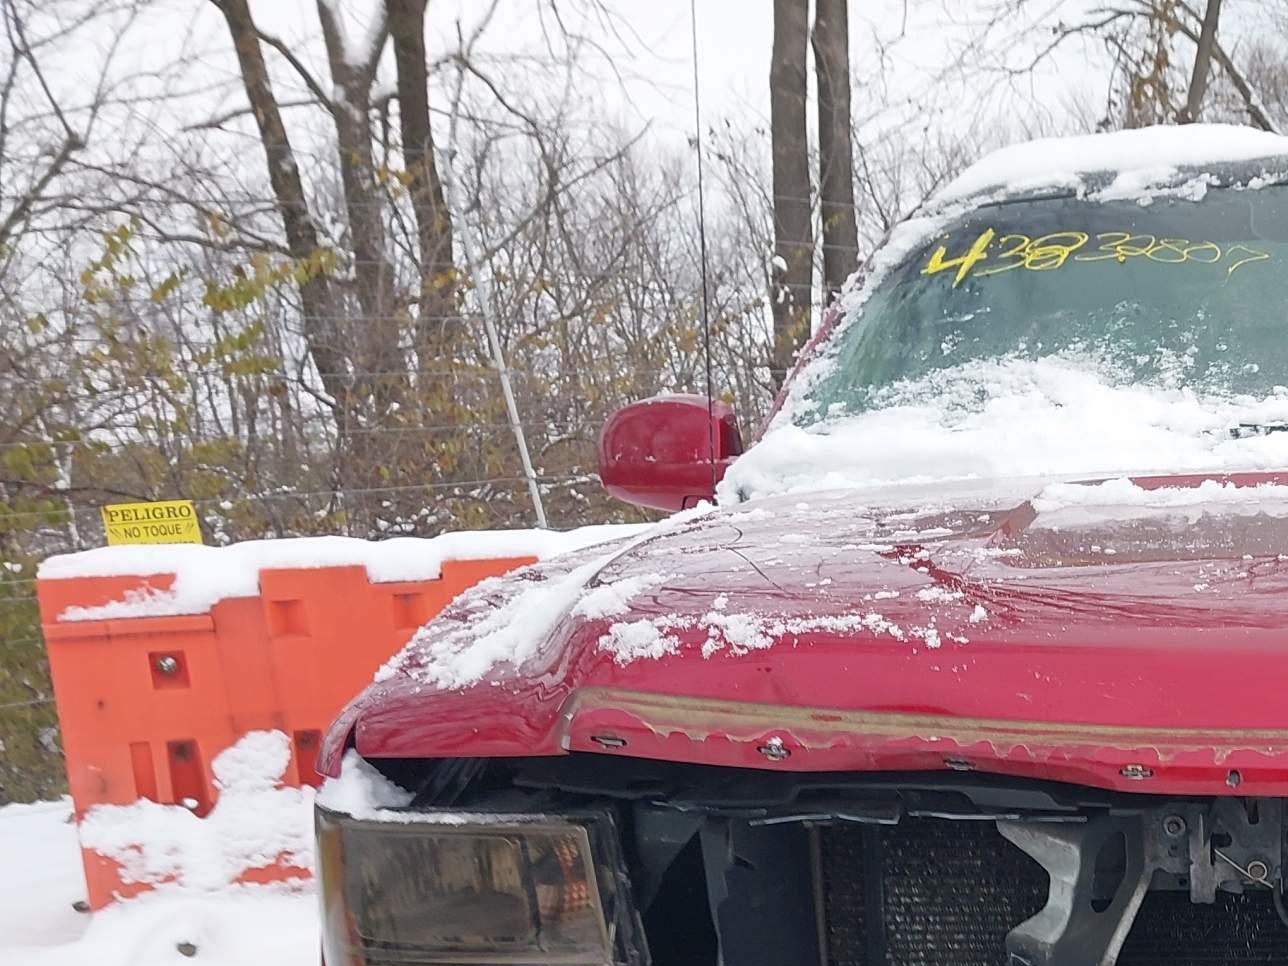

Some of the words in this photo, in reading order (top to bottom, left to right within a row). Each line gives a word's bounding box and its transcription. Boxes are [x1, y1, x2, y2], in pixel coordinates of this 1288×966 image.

[109, 505, 191, 522] PELIGRO
[124, 527, 141, 538] NO
[143, 524, 182, 537] TOQUE
